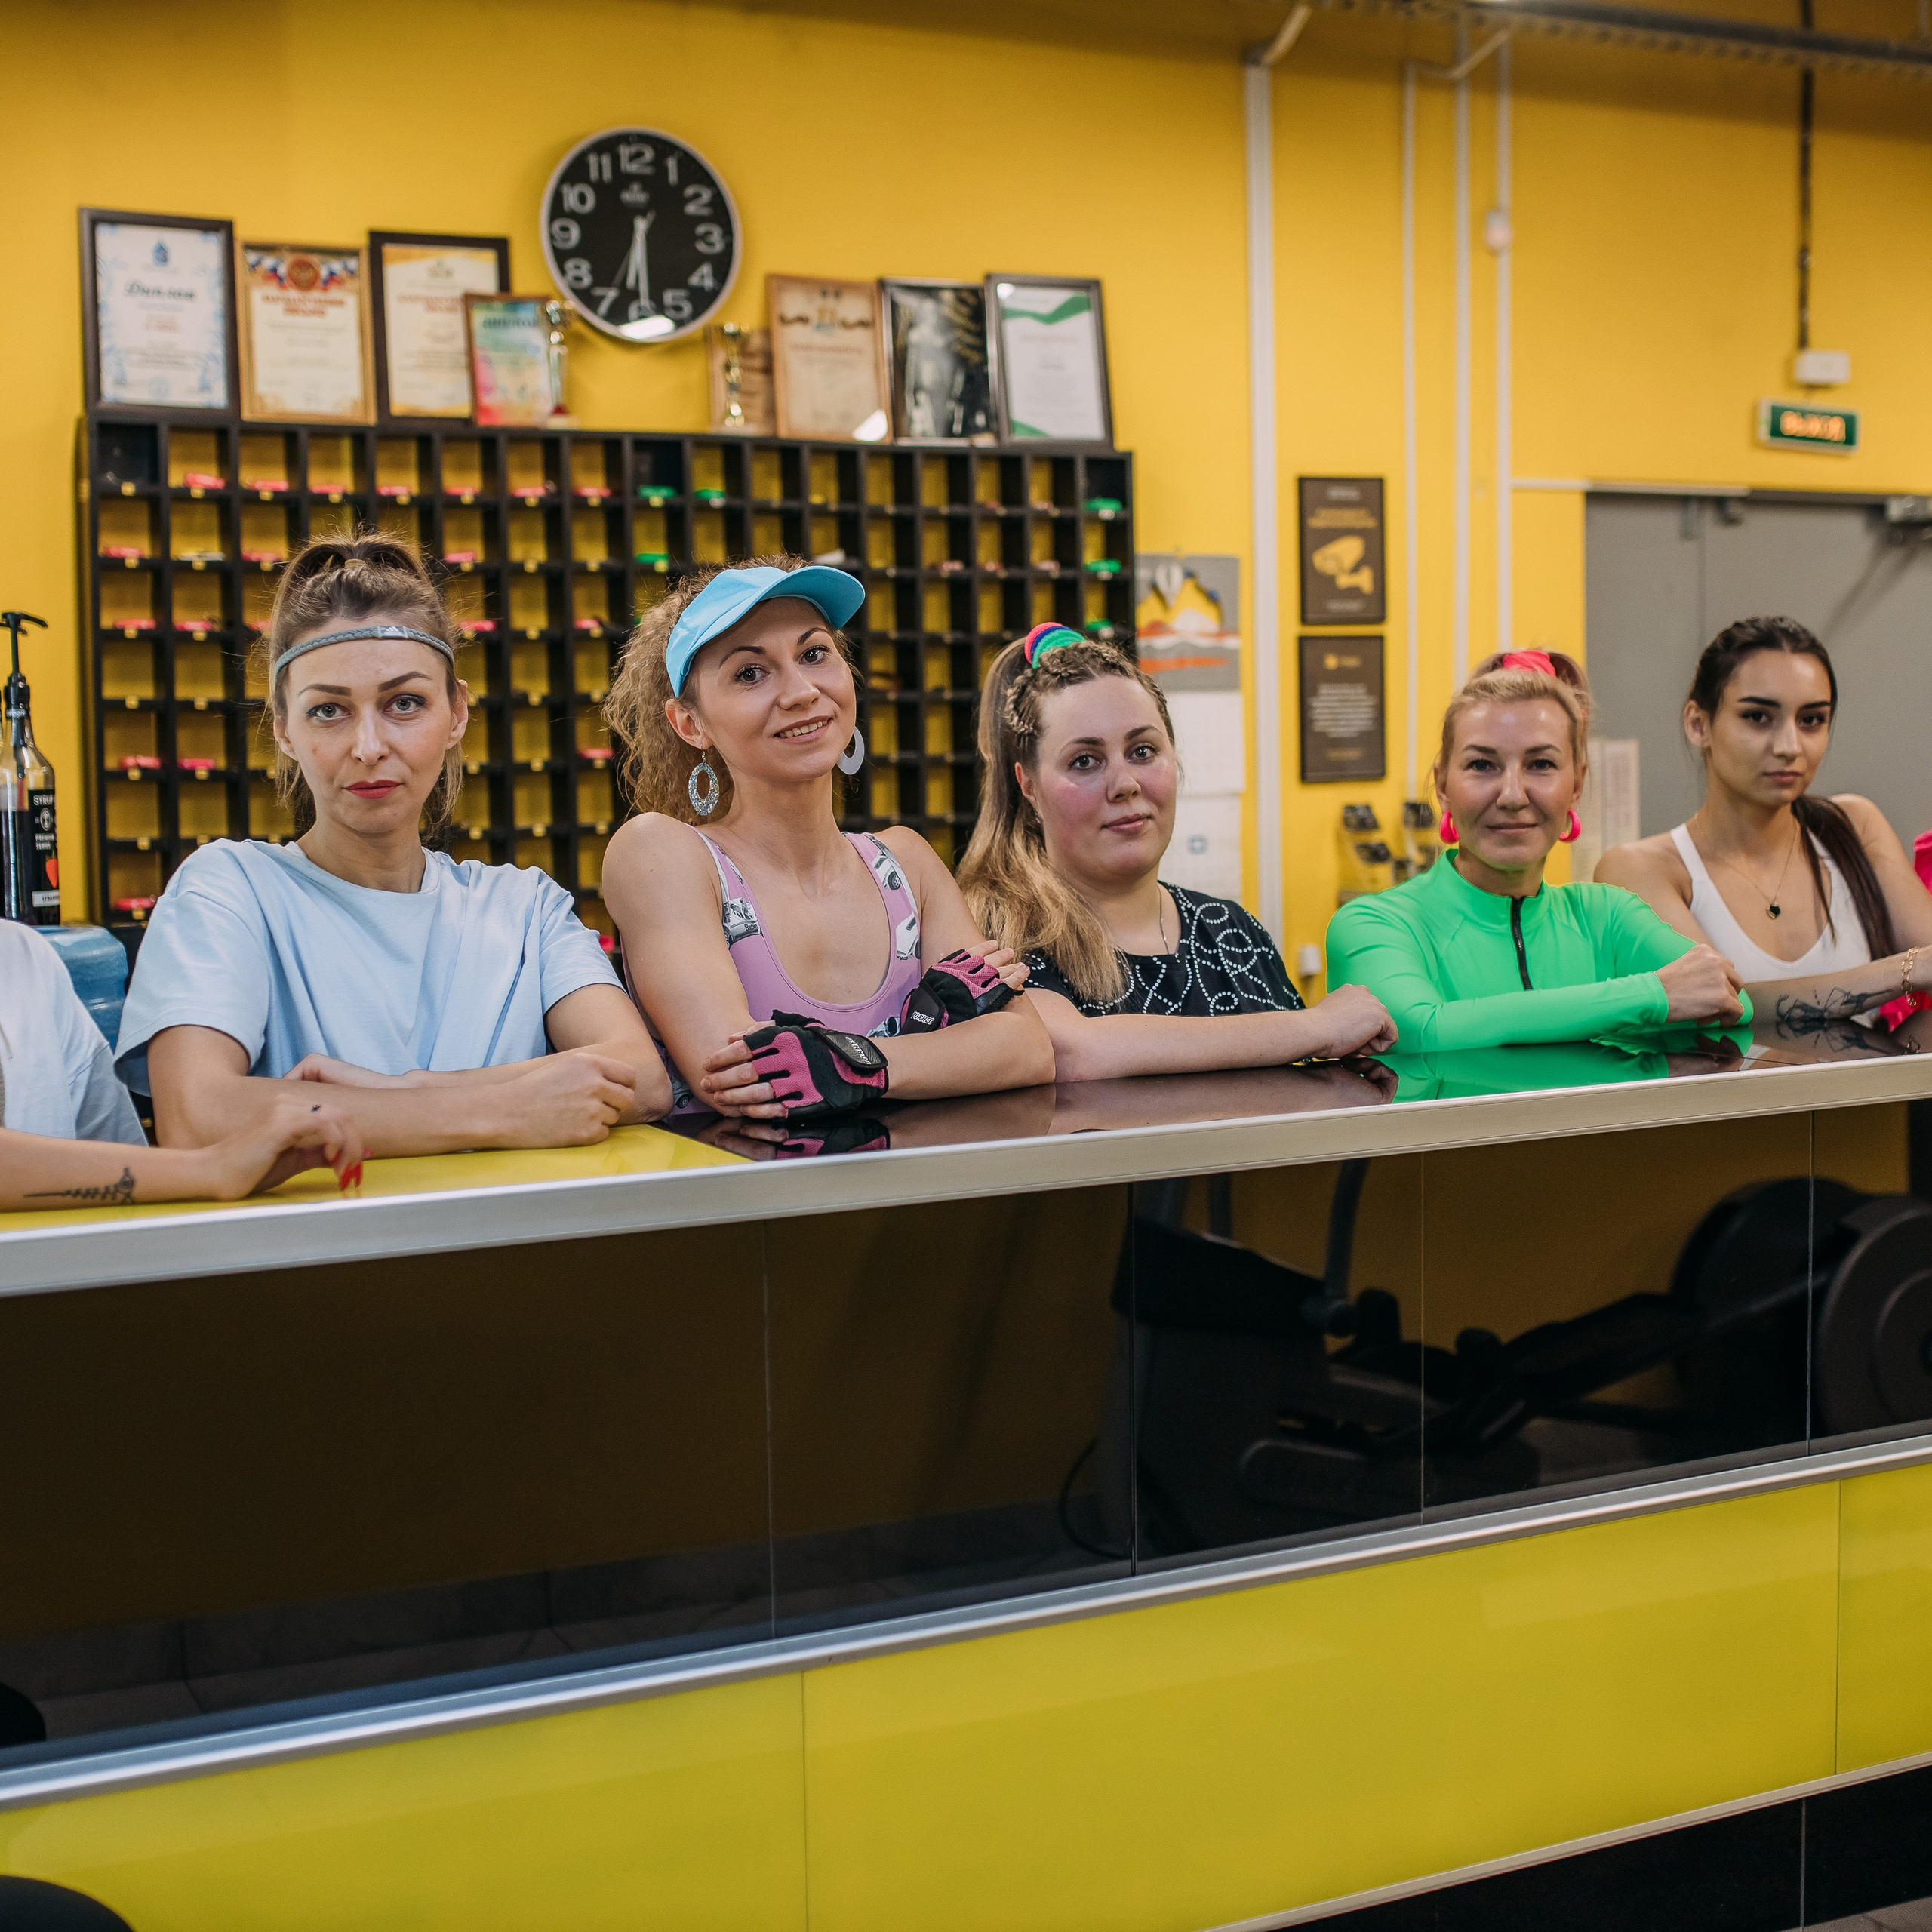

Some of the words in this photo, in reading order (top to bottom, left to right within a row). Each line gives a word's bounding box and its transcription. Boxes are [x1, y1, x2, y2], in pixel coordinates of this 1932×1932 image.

[588, 152, 612, 183] 11
[618, 142, 656, 175] 12
[666, 155, 679, 186] 1
[561, 182, 596, 215] 10
[682, 184, 714, 217] 2
[550, 217, 581, 250] 9
[694, 223, 726, 255] 3
[564, 257, 593, 290] 8
[688, 262, 715, 292] 4
[590, 287, 620, 318] 7
[662, 288, 694, 321] 5
[910, 1011, 935, 1025] TORNEO
